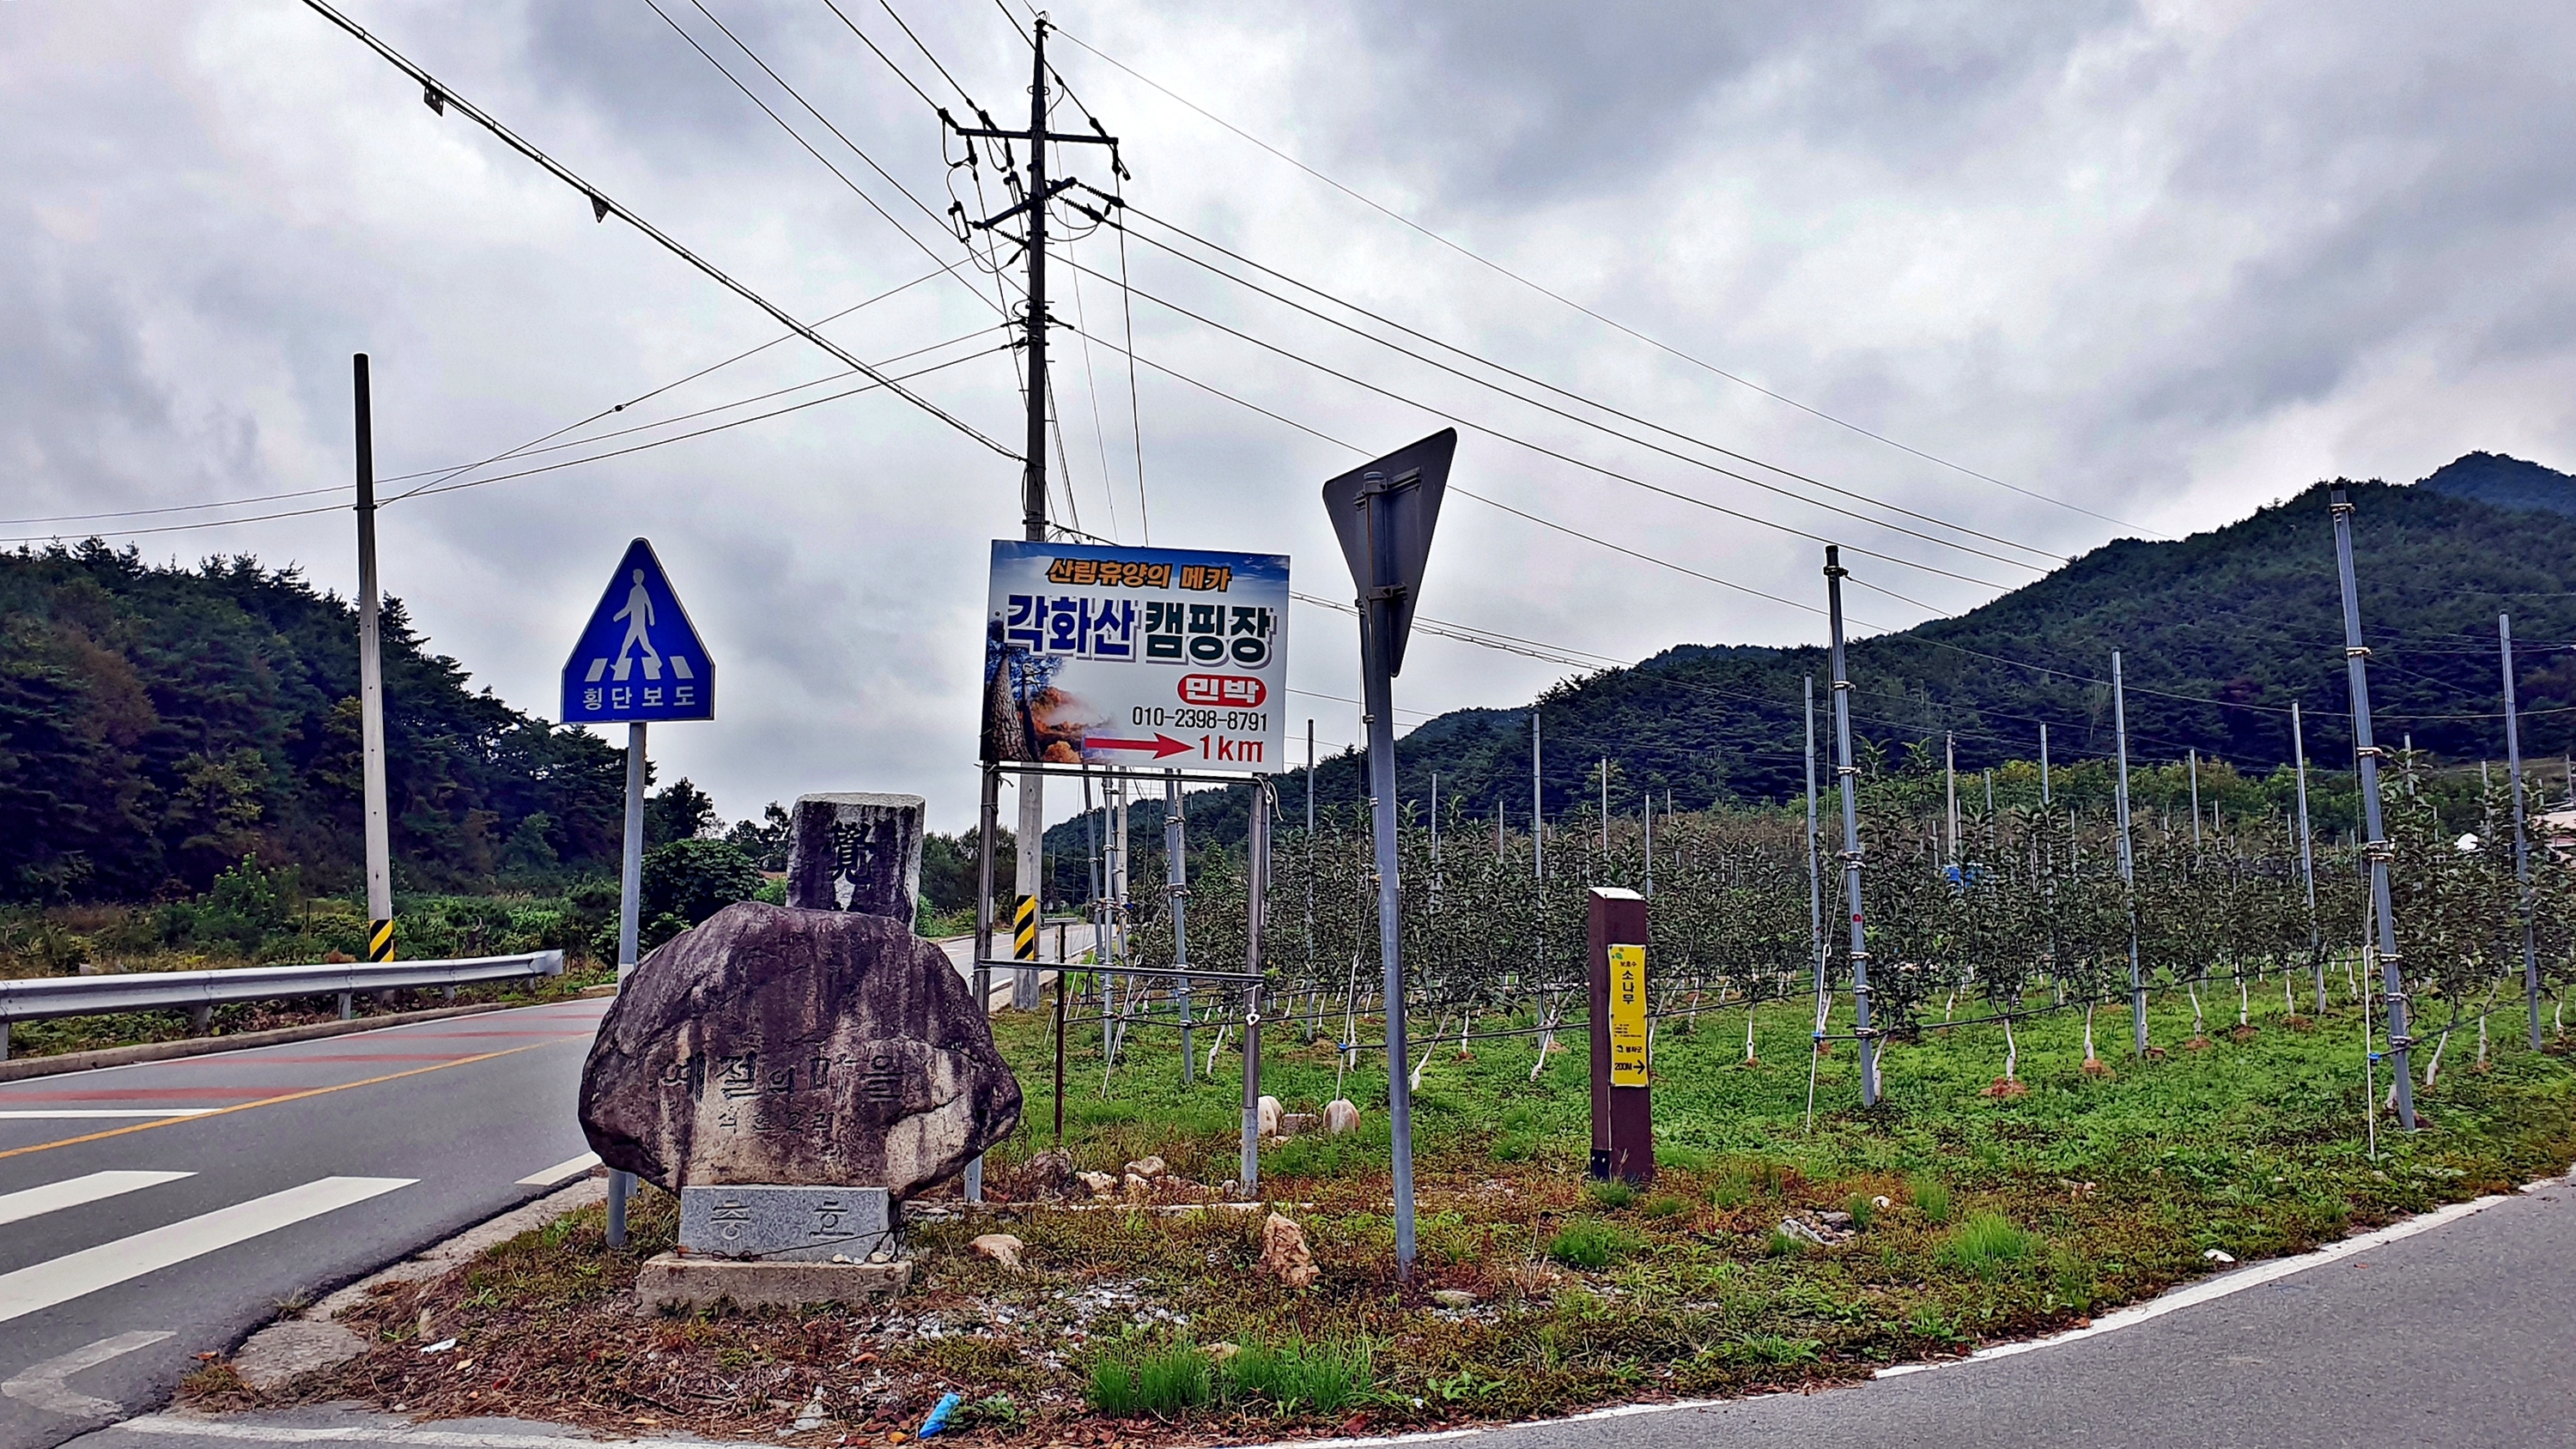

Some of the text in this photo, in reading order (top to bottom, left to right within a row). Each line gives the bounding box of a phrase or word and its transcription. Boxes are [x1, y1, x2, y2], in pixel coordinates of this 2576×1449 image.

[1047, 558, 1231, 592] 산림휴양의 메카
[1006, 593, 1273, 665] 각화산 캠핑장
[582, 686, 696, 711] 횡단보도
[1186, 677, 1260, 704] 민박
[1132, 706, 1267, 732] 010-2398-8791
[1199, 734, 1264, 763] 1km
[821, 820, 878, 912] 覺
[1622, 969, 1635, 1005] 소나무
[660, 1049, 795, 1104] 예절의
